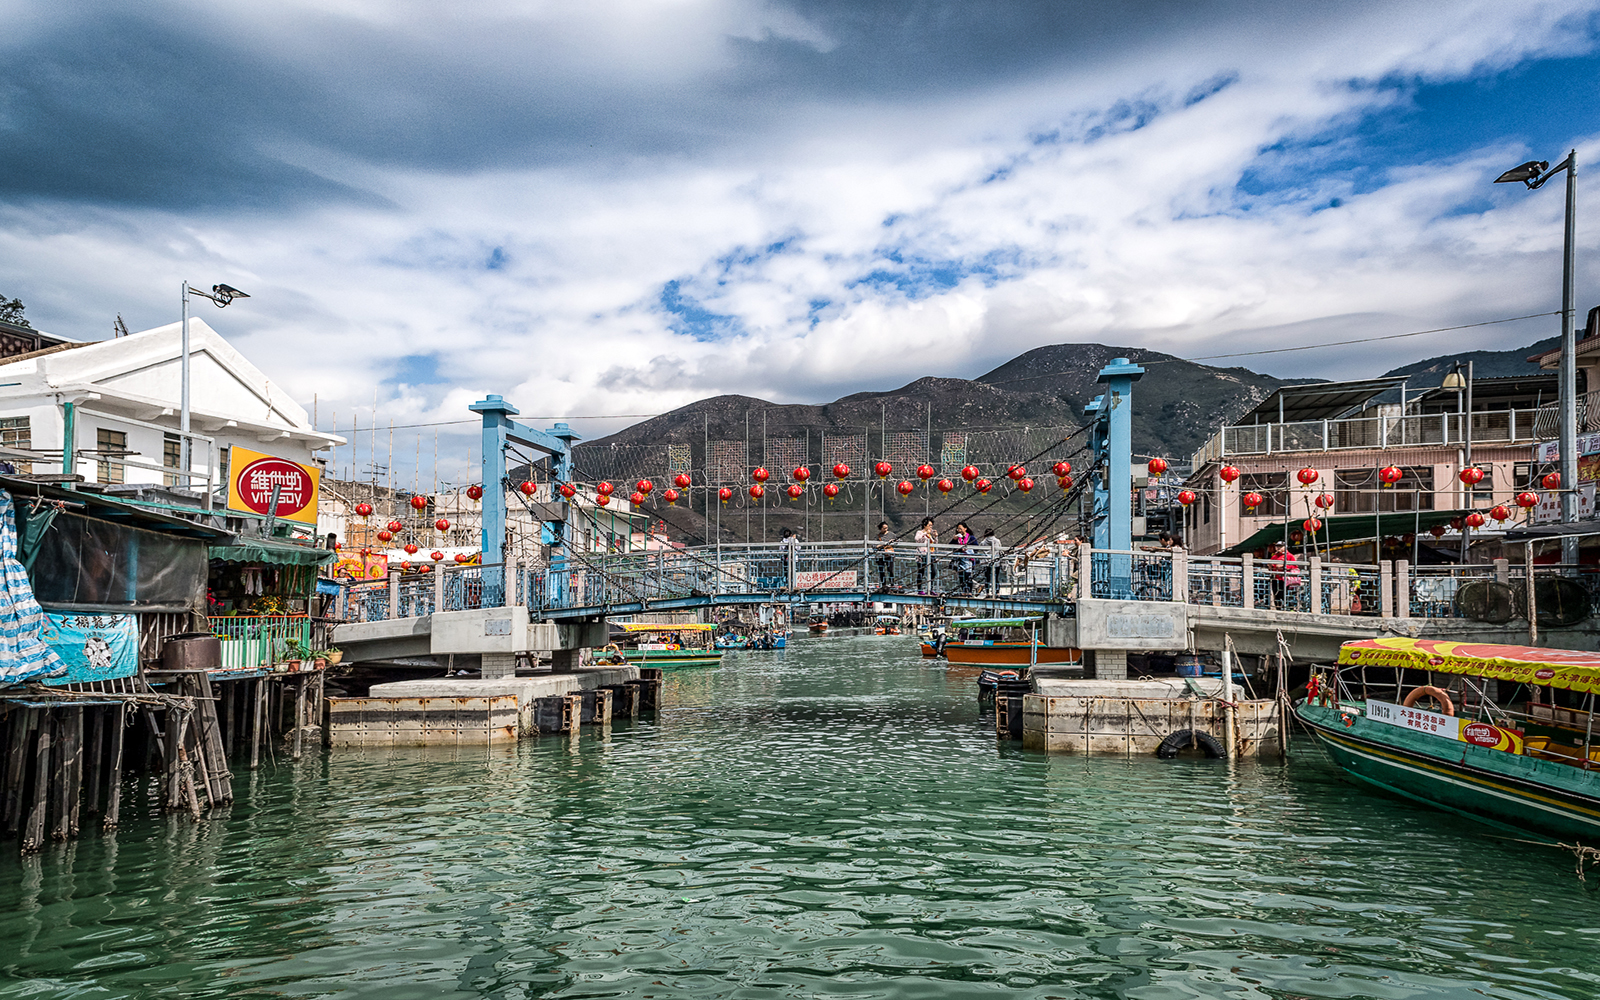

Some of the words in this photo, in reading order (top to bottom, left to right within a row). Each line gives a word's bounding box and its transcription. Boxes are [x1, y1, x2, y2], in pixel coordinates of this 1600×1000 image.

[250, 469, 302, 491] 維他奶
[1371, 704, 1391, 719] 119178
